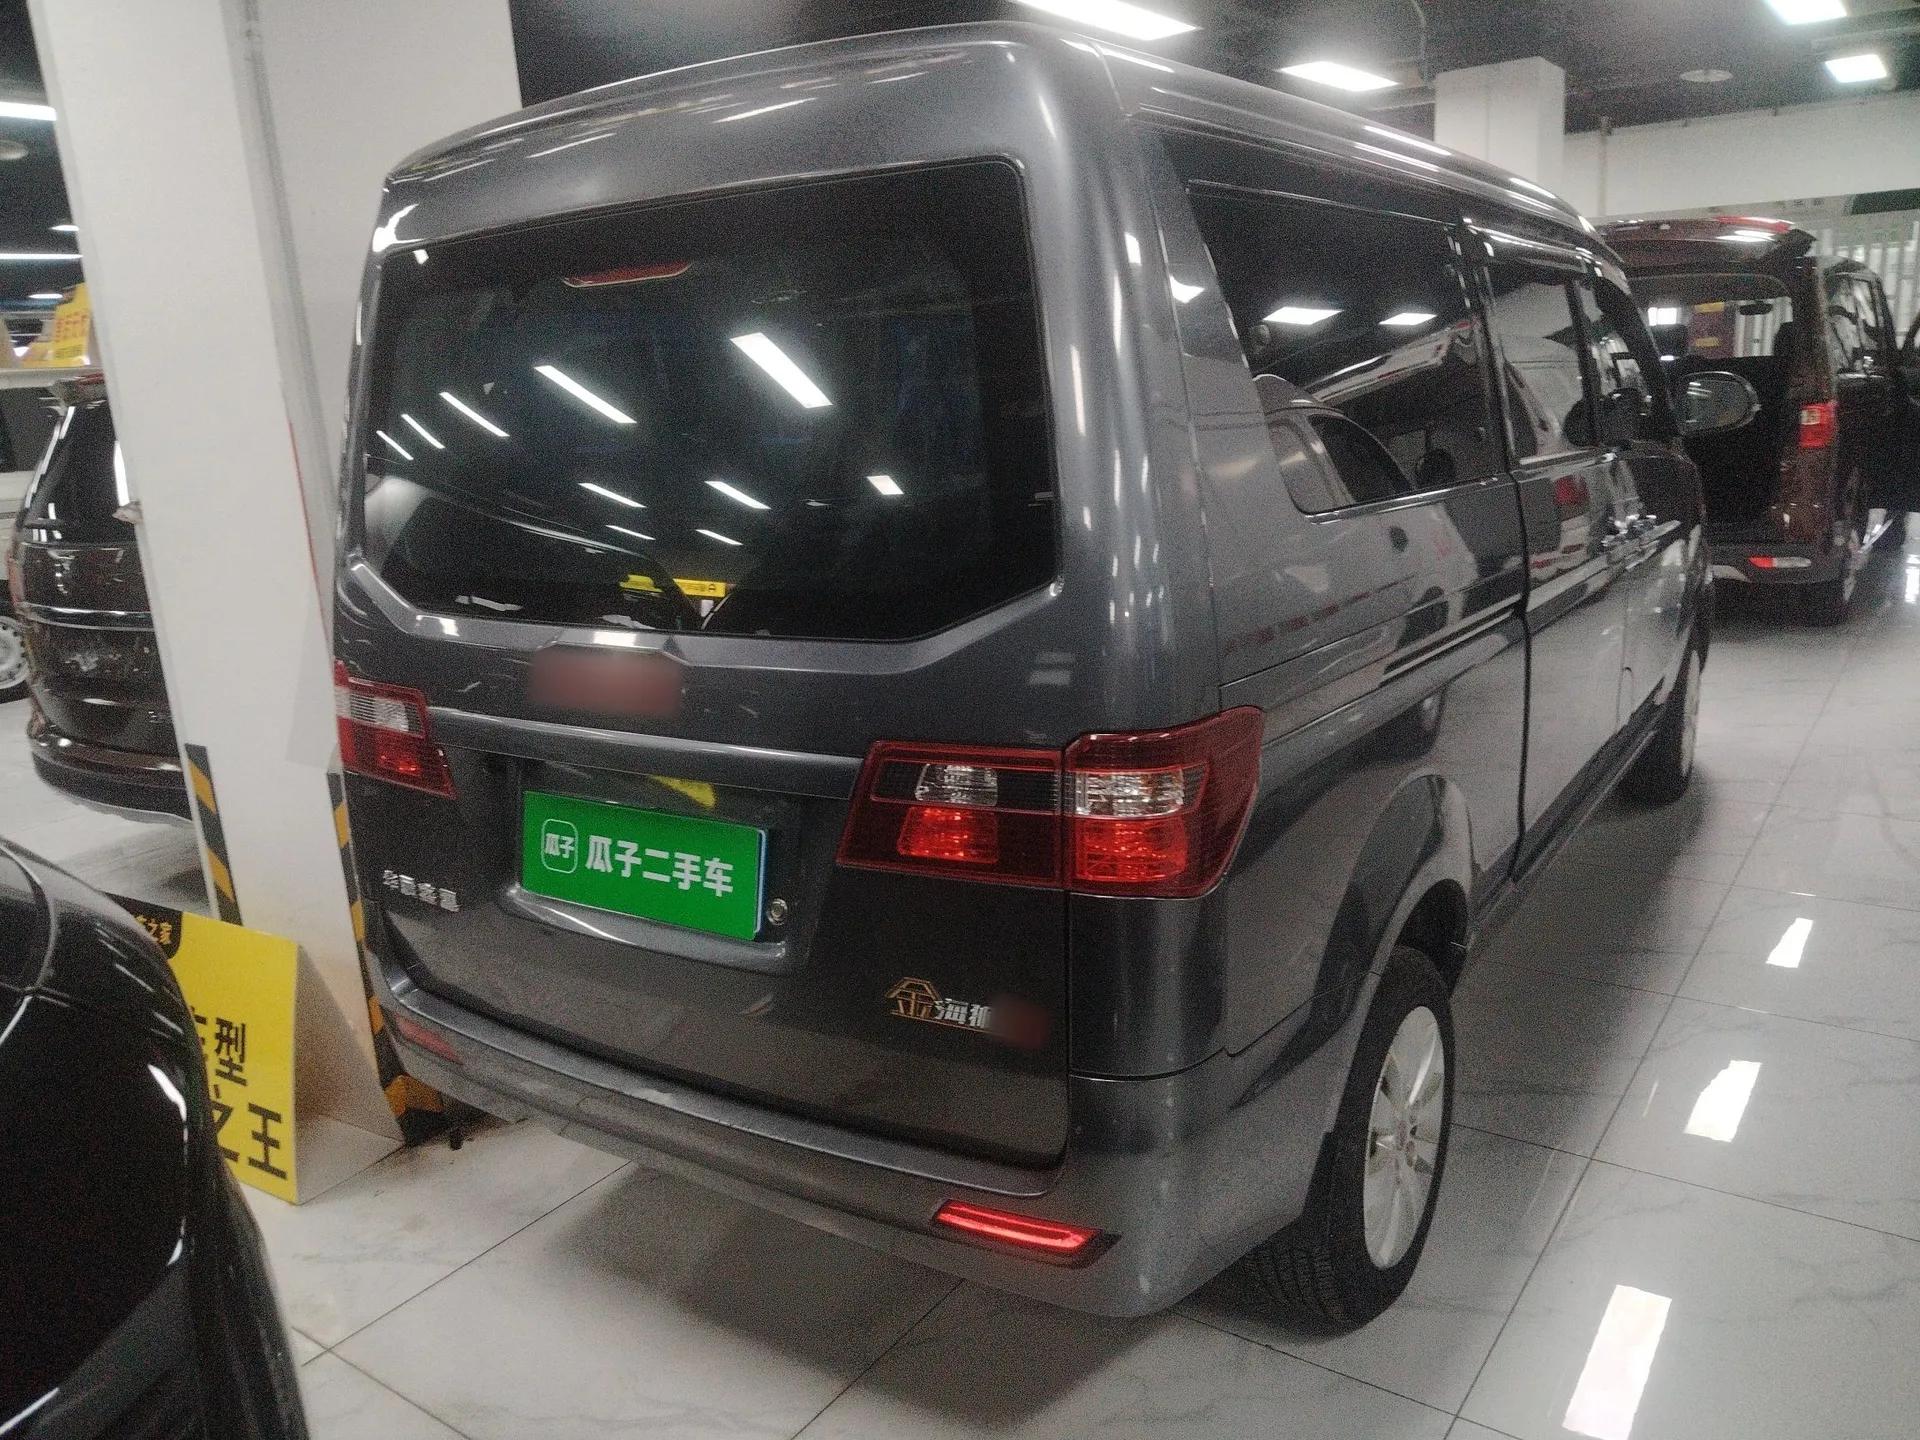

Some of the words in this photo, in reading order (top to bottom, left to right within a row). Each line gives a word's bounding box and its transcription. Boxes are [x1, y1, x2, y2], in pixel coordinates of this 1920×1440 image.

[544, 832, 576, 859] 瓜子
[585, 834, 735, 897] 瓜子二手车
